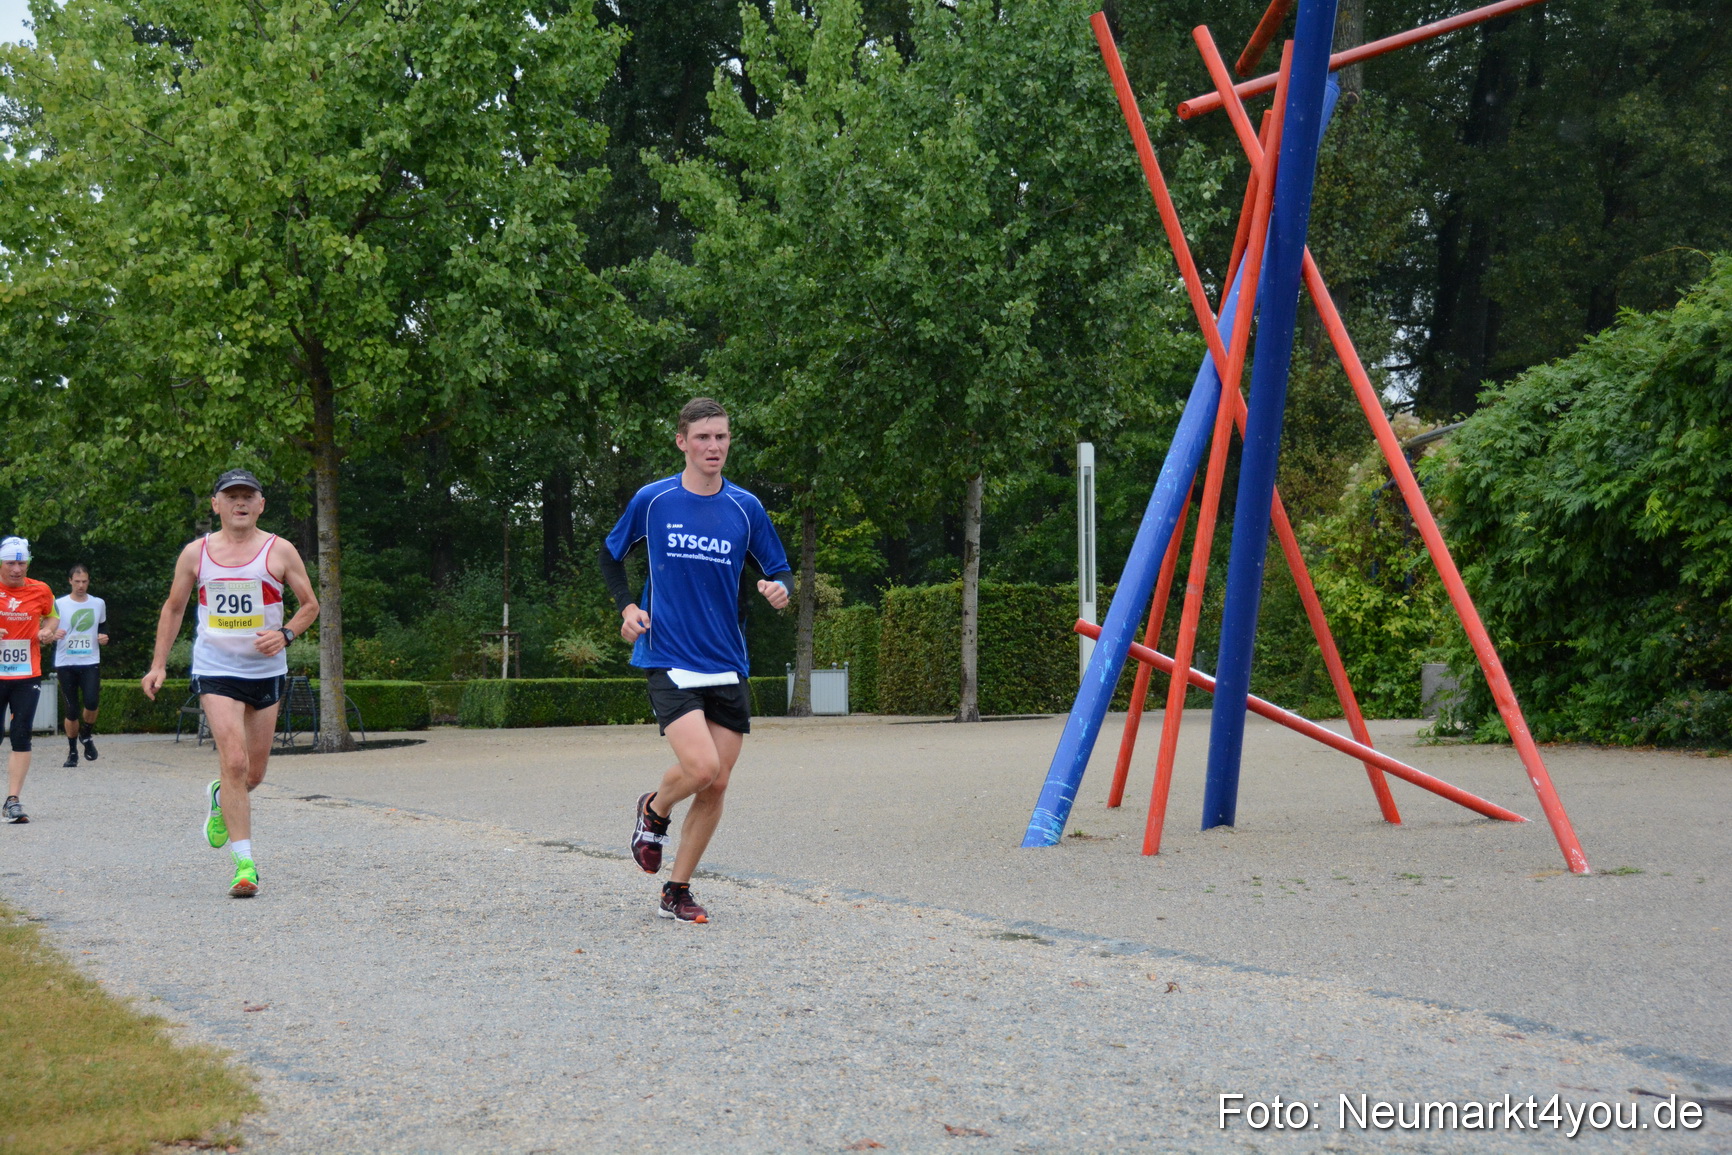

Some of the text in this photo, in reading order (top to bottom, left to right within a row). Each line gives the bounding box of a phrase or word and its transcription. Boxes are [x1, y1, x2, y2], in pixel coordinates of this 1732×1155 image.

[667, 533, 731, 554] SYSCAD
[215, 593, 253, 614] 296
[218, 618, 253, 629] Siegfried
[68, 639, 91, 649] 2715
